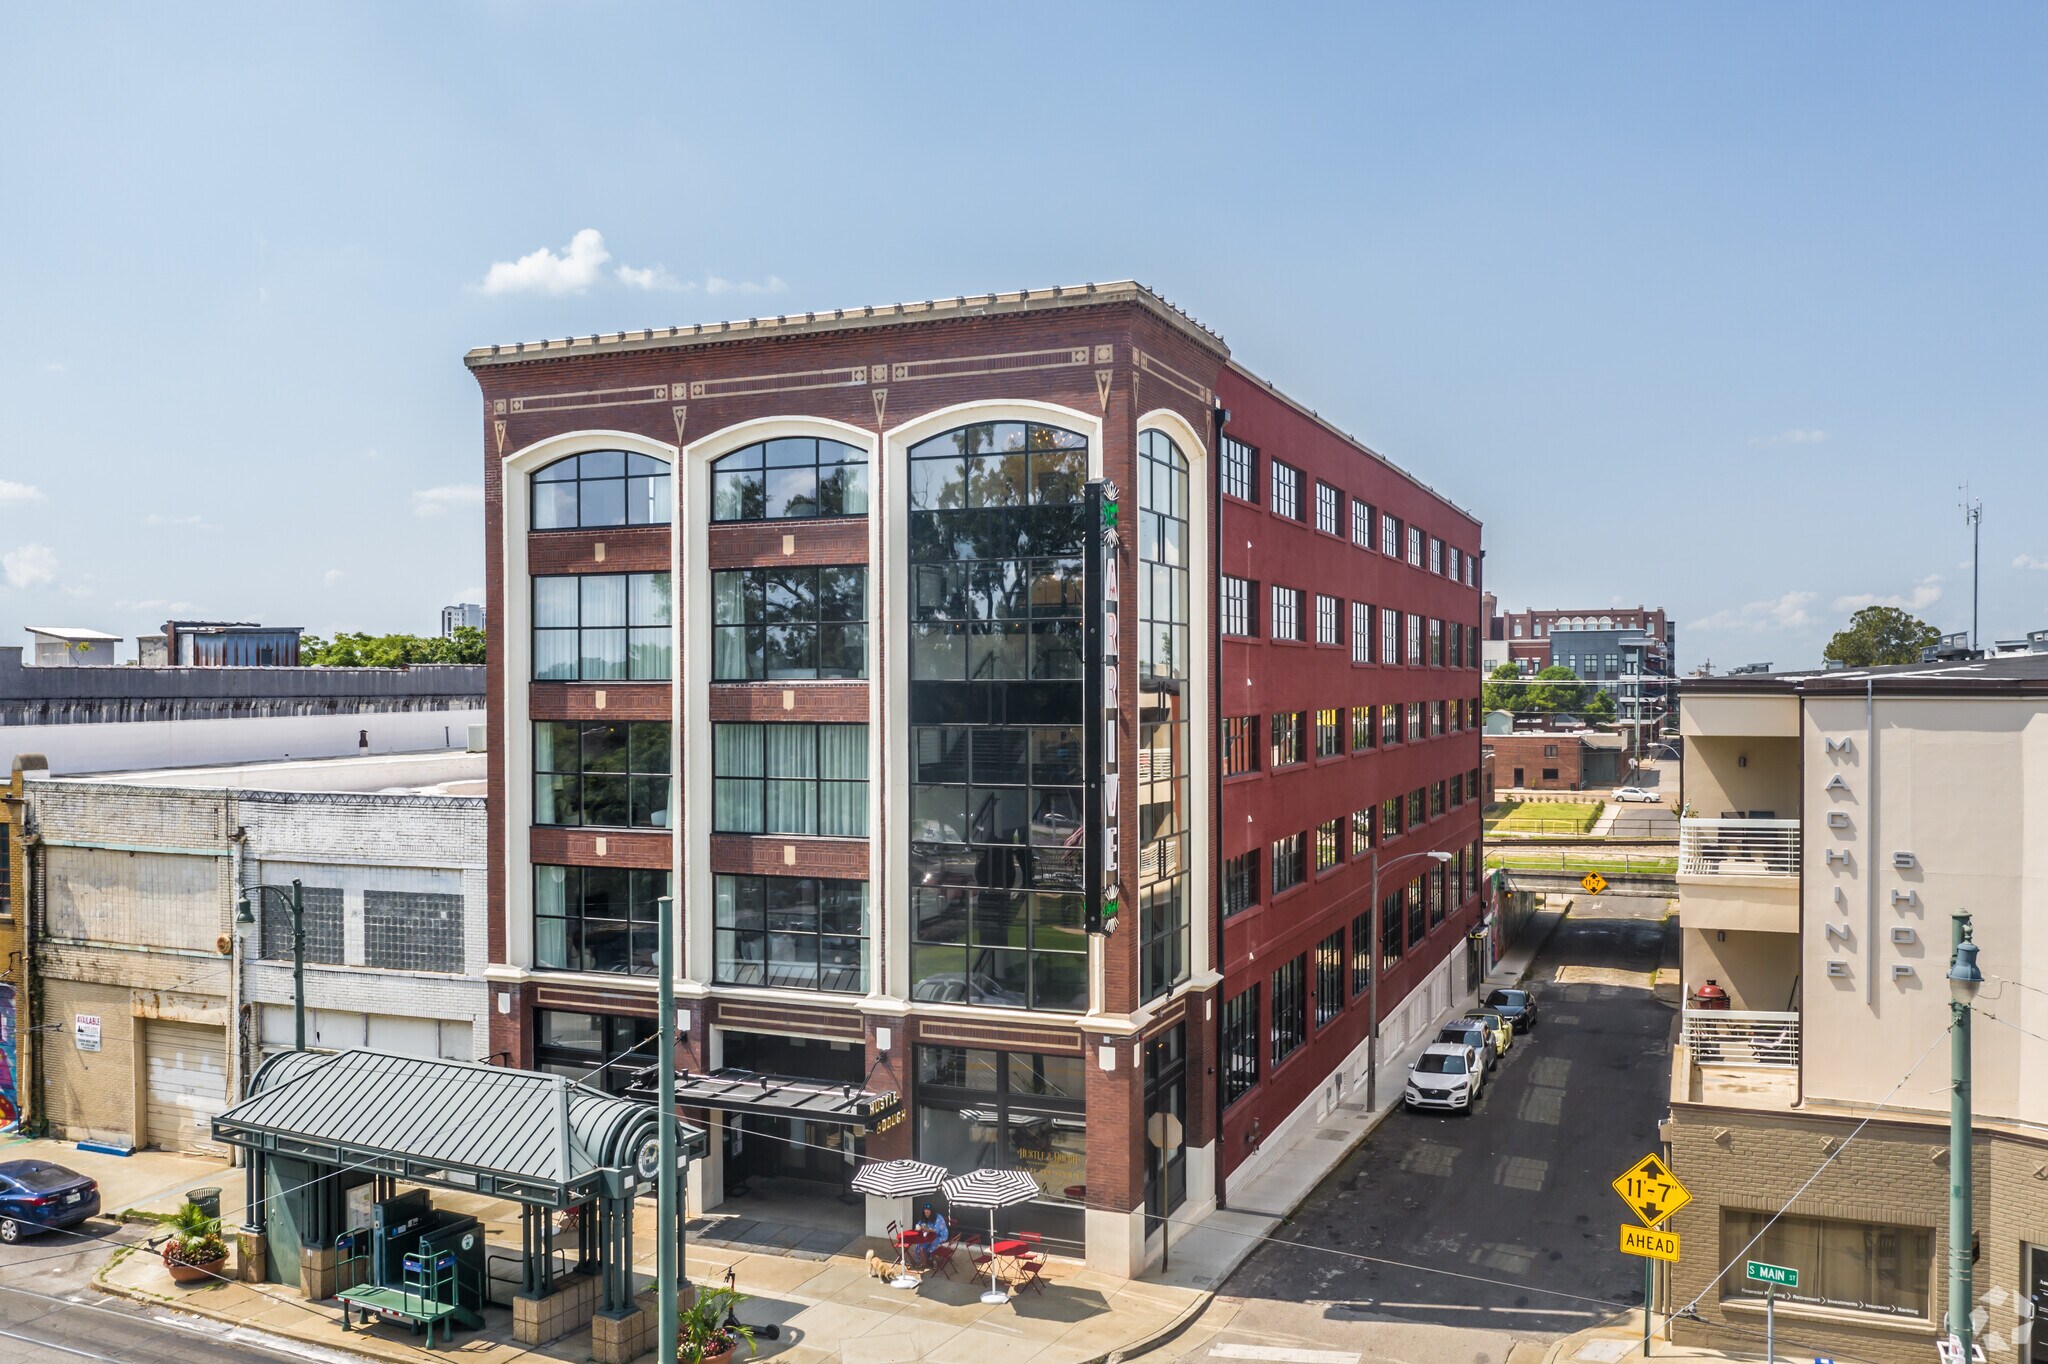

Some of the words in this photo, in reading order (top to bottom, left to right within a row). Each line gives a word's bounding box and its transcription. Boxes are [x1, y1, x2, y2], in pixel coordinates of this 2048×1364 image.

[1105, 558, 1119, 872] ARRIVE
[1825, 736, 1851, 978] MACHINE
[1891, 851, 1915, 981] SHOP
[77, 1015, 100, 1026] AVAILABLE
[869, 1091, 897, 1116] HUSTLE
[1626, 1233, 1674, 1253] AHEAD
[1749, 1265, 1755, 1275] S
[1760, 1266, 1785, 1281] MAIN
[1741, 1287, 1764, 1296] Financial
[1792, 1294, 1821, 1303] Retirement
[1827, 1298, 1859, 1307] Investments
[1865, 1303, 1891, 1311] Insurance
[1897, 1306, 1919, 1315] Banking
